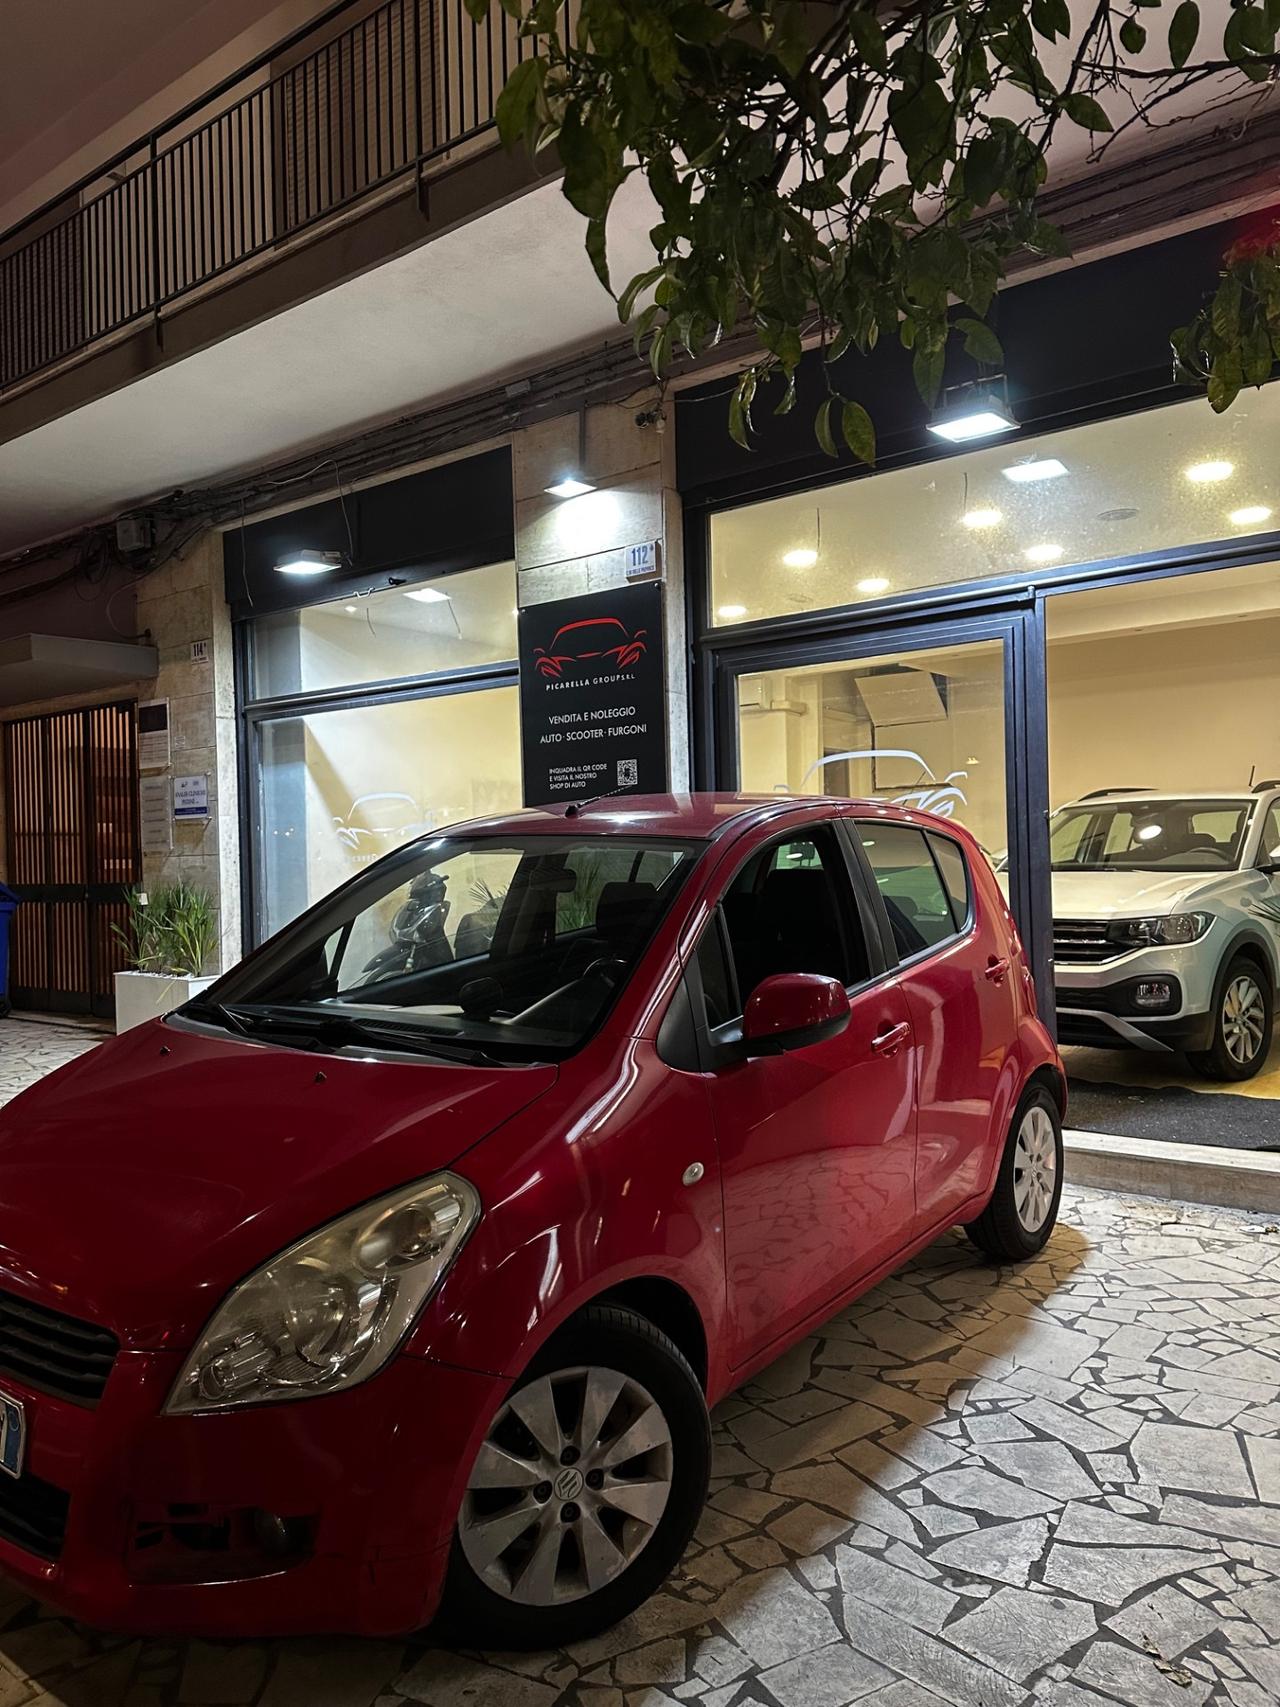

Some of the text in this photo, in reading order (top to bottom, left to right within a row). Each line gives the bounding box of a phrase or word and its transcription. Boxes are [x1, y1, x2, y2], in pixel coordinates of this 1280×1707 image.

[545, 679, 590, 691] PICARELLA
[548, 706, 636, 725] VENDITA E NOLEGGIO
[540, 724, 647, 744] AUTO SCOOTER FURGONI
[549, 767, 577, 775] INQUADRA
[591, 763, 607, 771] CODE
[575, 772, 597, 780] NOSTRO
